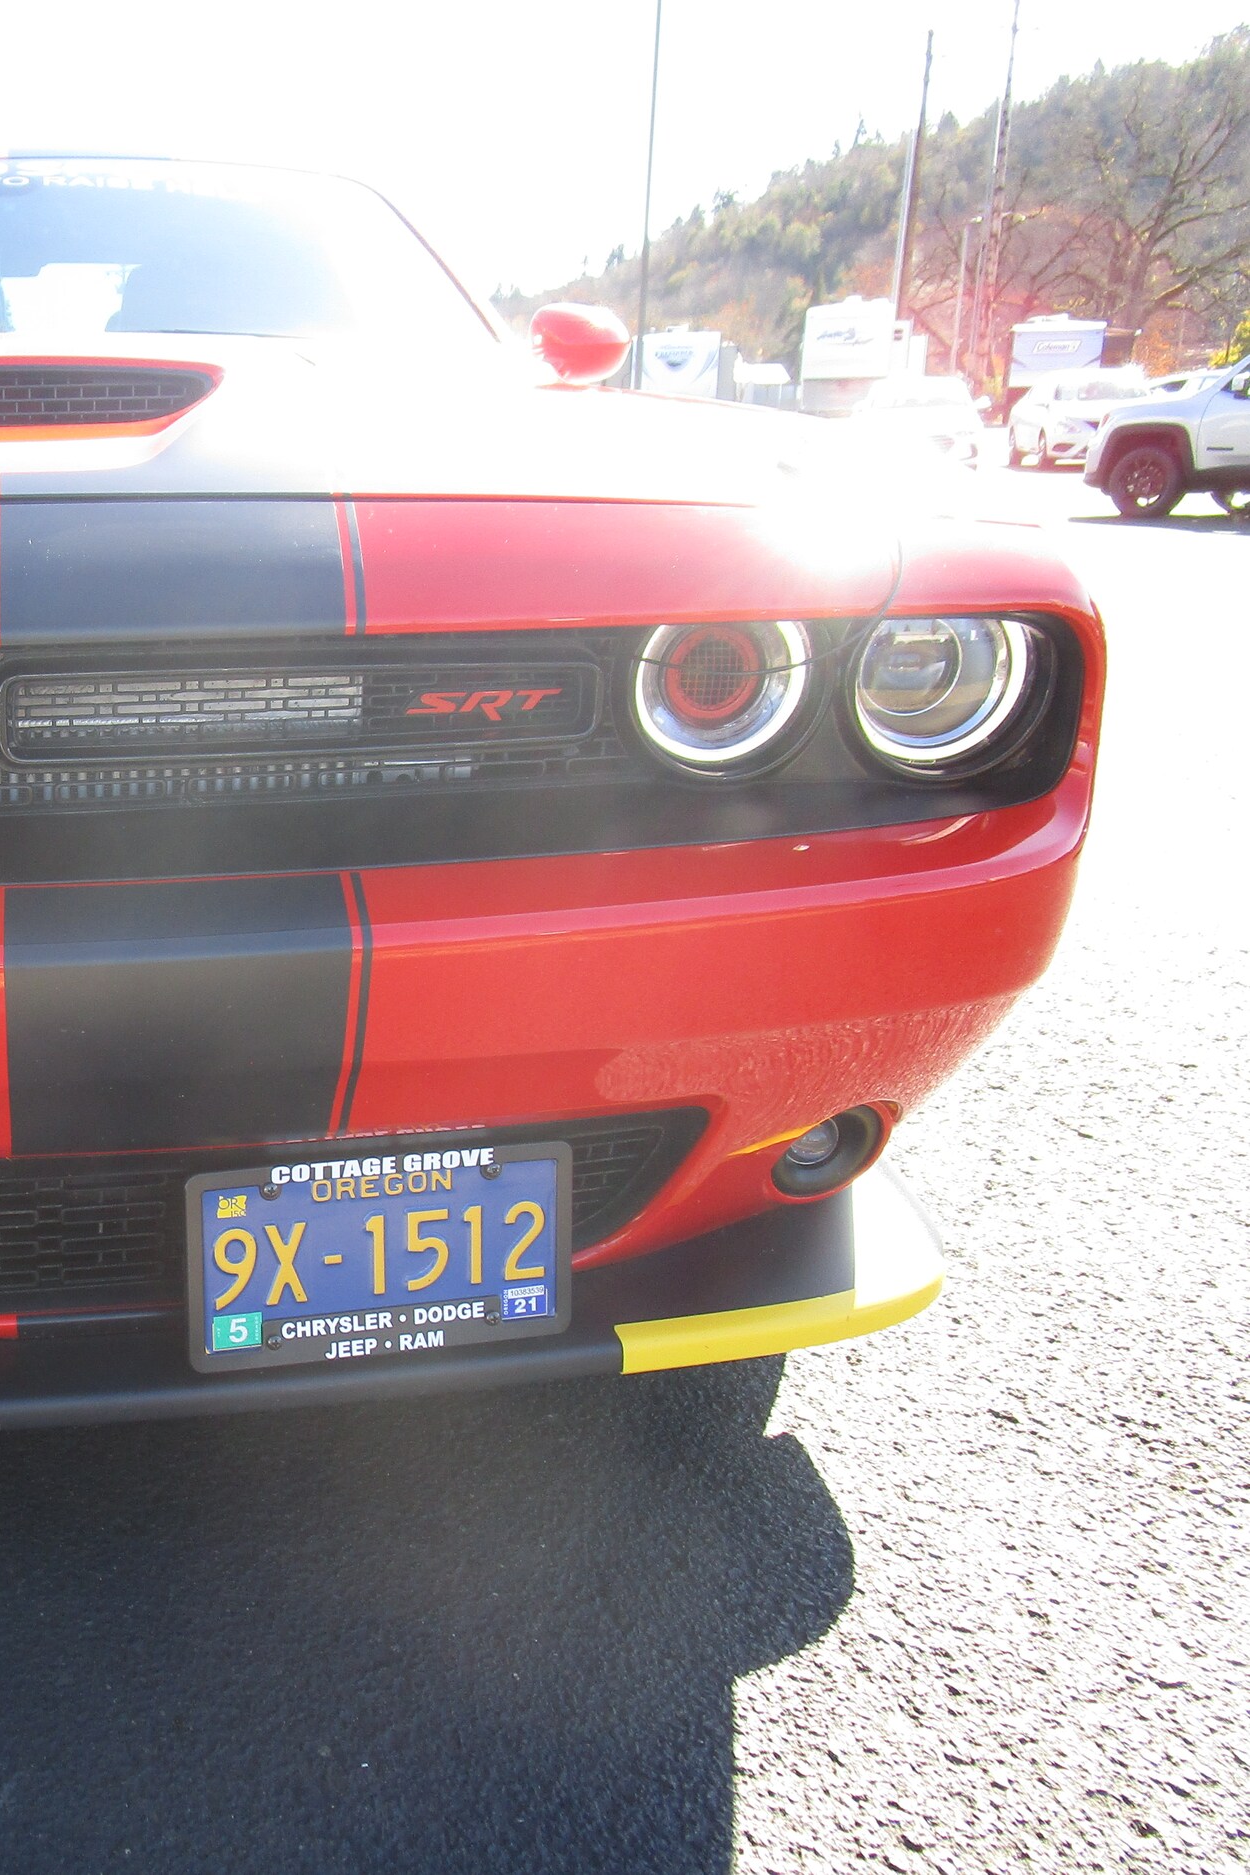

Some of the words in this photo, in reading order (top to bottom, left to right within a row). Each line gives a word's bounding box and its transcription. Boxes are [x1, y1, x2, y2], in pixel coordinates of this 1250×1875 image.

[405, 687, 563, 721] SRT
[271, 1156, 396, 1184] COTTAGE
[403, 1147, 494, 1172] GROVE
[312, 1170, 452, 1202] OREGON
[218, 1197, 245, 1210] OR
[214, 1201, 546, 1310] 9X-1512
[281, 1312, 393, 1339] CHRYSLER
[414, 1301, 485, 1325] DODGE
[514, 1297, 537, 1314] 21
[228, 1317, 249, 1343] 5
[325, 1338, 378, 1360] JEEP
[400, 1330, 445, 1351] RAM
